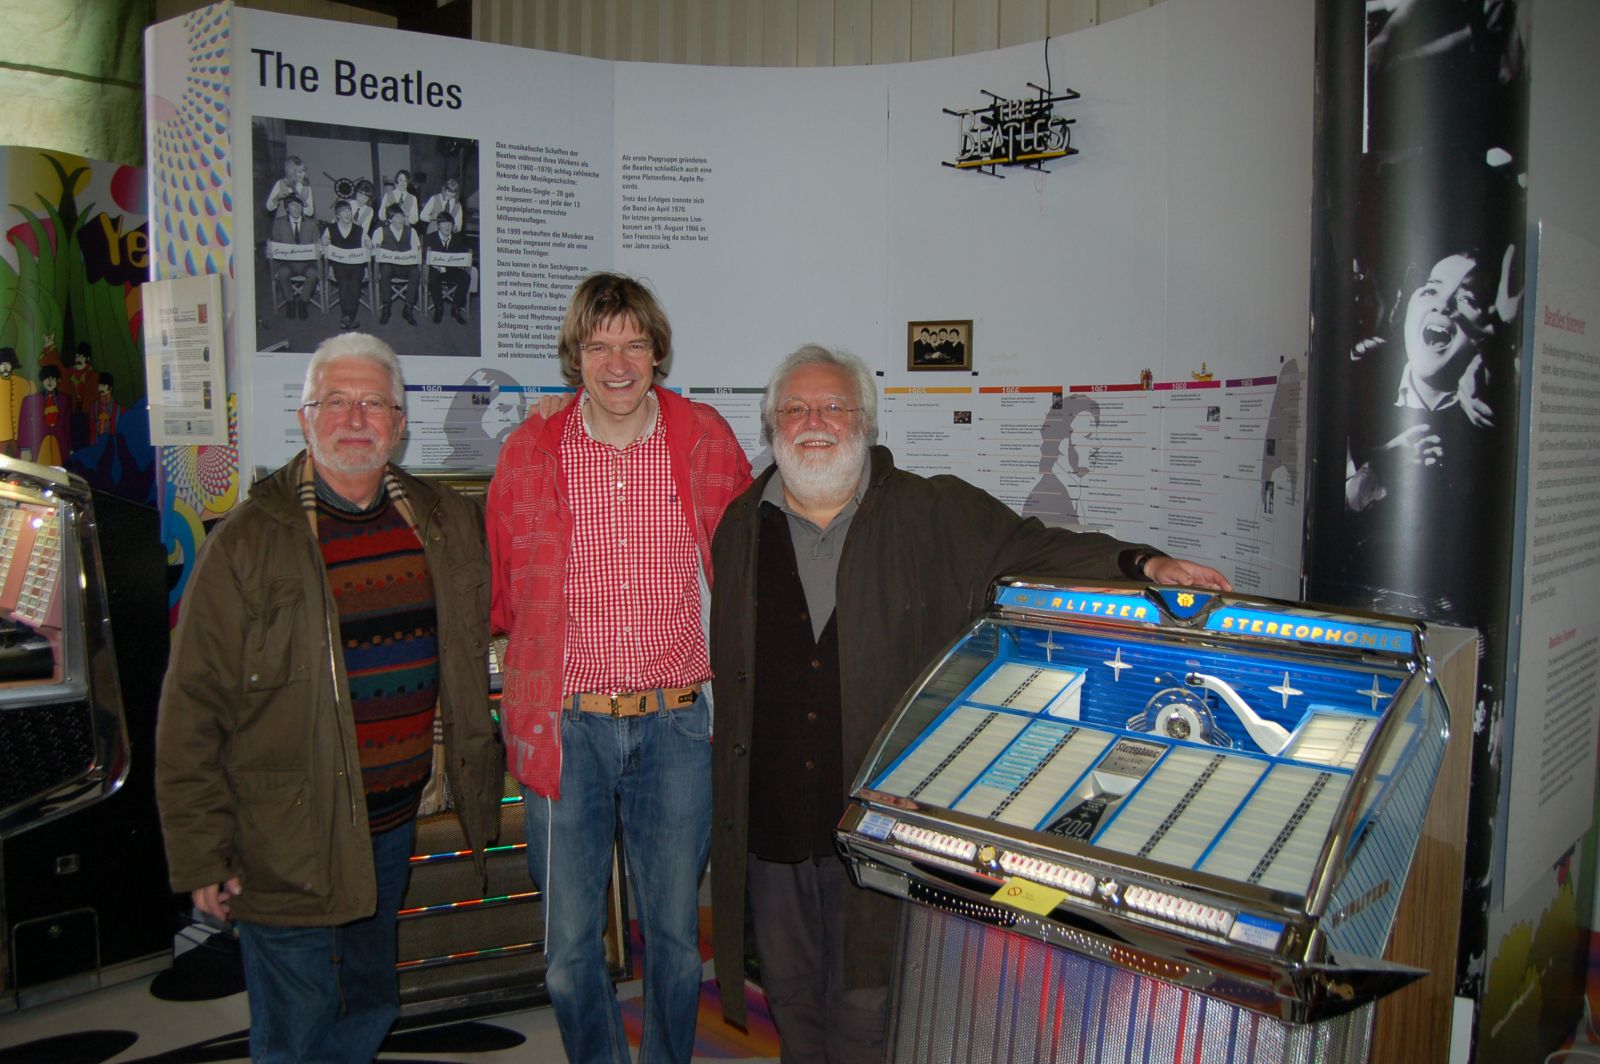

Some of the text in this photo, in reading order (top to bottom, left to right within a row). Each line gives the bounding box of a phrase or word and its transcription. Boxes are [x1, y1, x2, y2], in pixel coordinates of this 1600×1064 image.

[251, 48, 463, 110] The Beatles
[996, 98, 1034, 121] THE
[957, 108, 1067, 162] BEATLES
[496, 141, 507, 149] Das
[544, 147, 568, 156] Schaffen
[496, 151, 517, 160] Beatles
[648, 155, 678, 164] Popgruppe
[496, 161, 517, 171] Gruppe
[496, 171, 519, 180] Rekorde
[520, 173, 529, 181] der
[679, 175, 695, 183] Apple
[550, 199, 562, 207] jede
[496, 205, 541, 215] Langspielplatten
[522, 229, 551, 238] verkauften
[561, 232, 583, 240] Musiker
[496, 237, 522, 245] Liverpool
[496, 247, 521, 255] Milliarde
[512, 261, 531, 269] kamen
[538, 262, 549, 270] den
[497, 270, 520, 278] gezählte
[508, 303, 557, 311] Gruppenformation
[498, 322, 529, 330] Schlagzeug
[1221, 617, 1404, 649] STEREOPHONIC
[1053, 817, 1092, 838] 200
